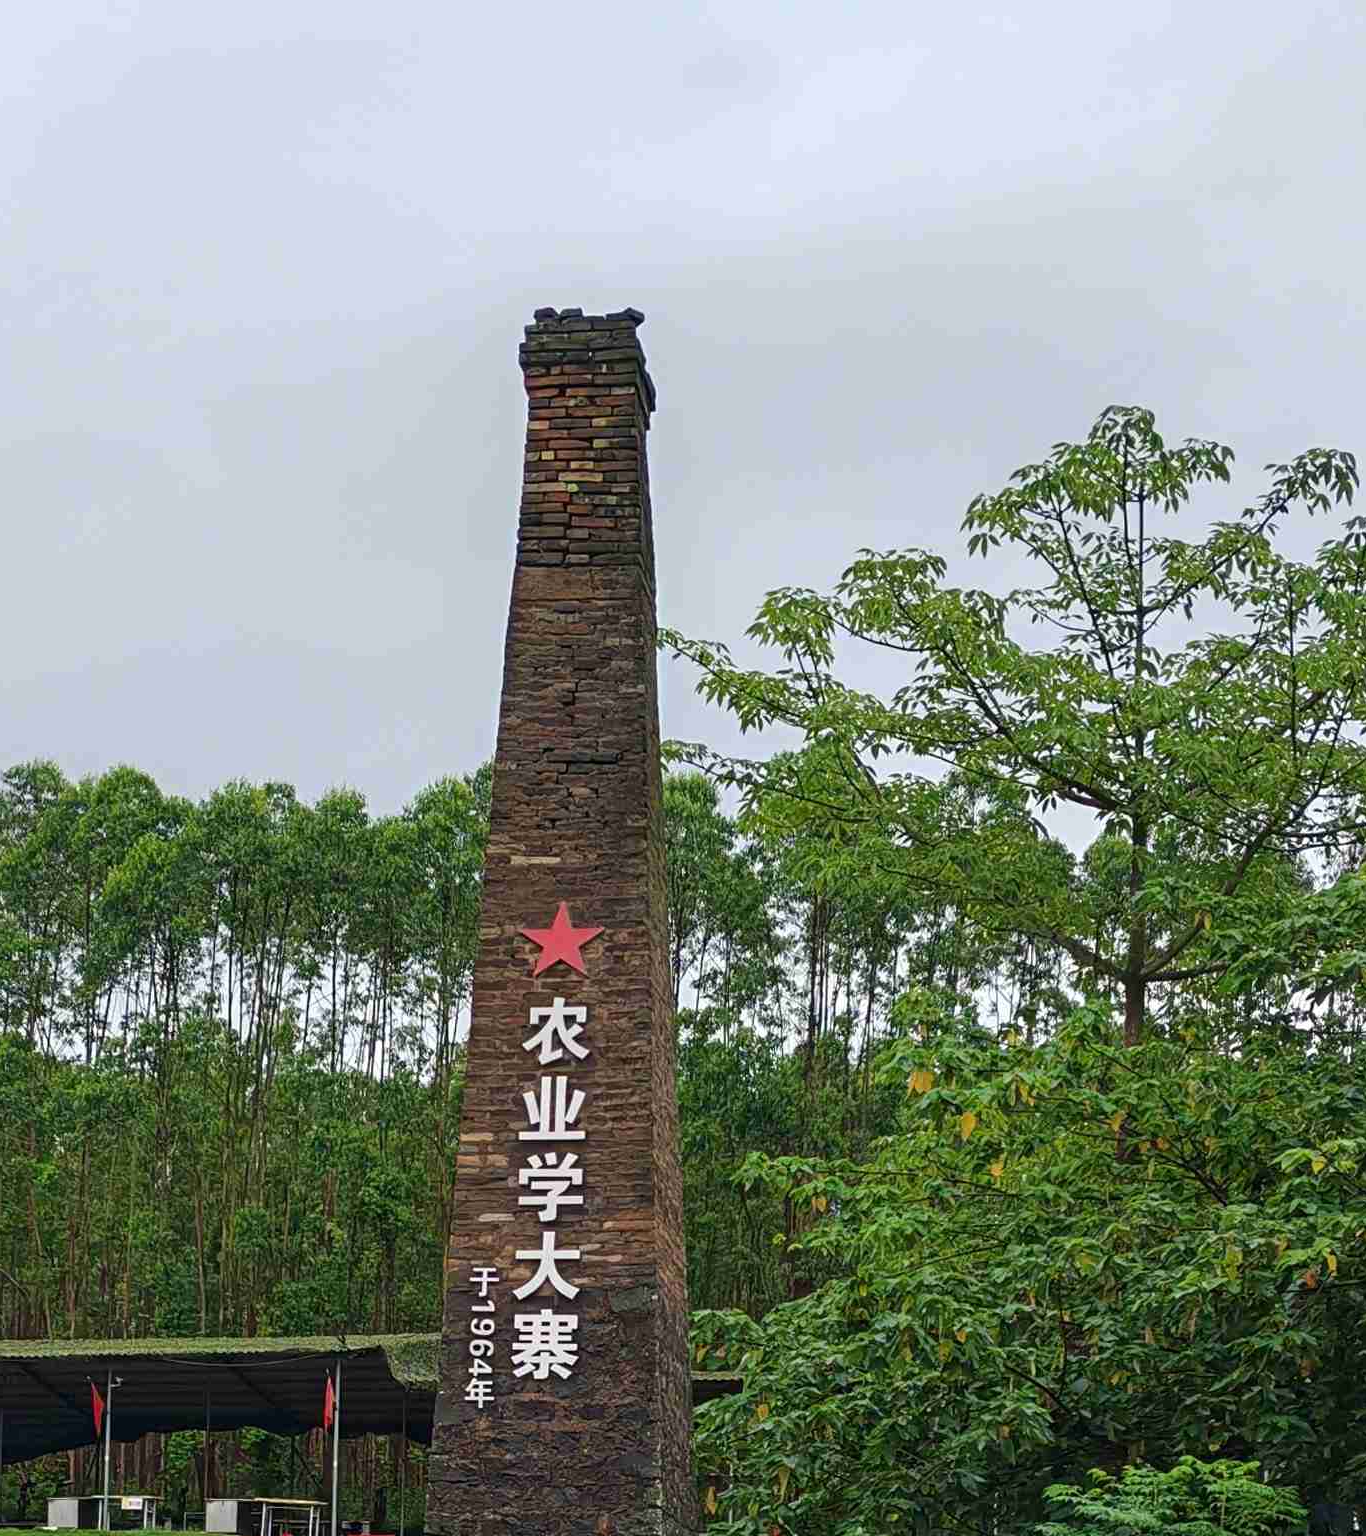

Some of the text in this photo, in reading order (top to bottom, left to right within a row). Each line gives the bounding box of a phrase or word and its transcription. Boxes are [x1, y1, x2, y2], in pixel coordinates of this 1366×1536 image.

[510, 997, 590, 1381] 农业学大寨
[464, 1266, 501, 1410] 于1964年
